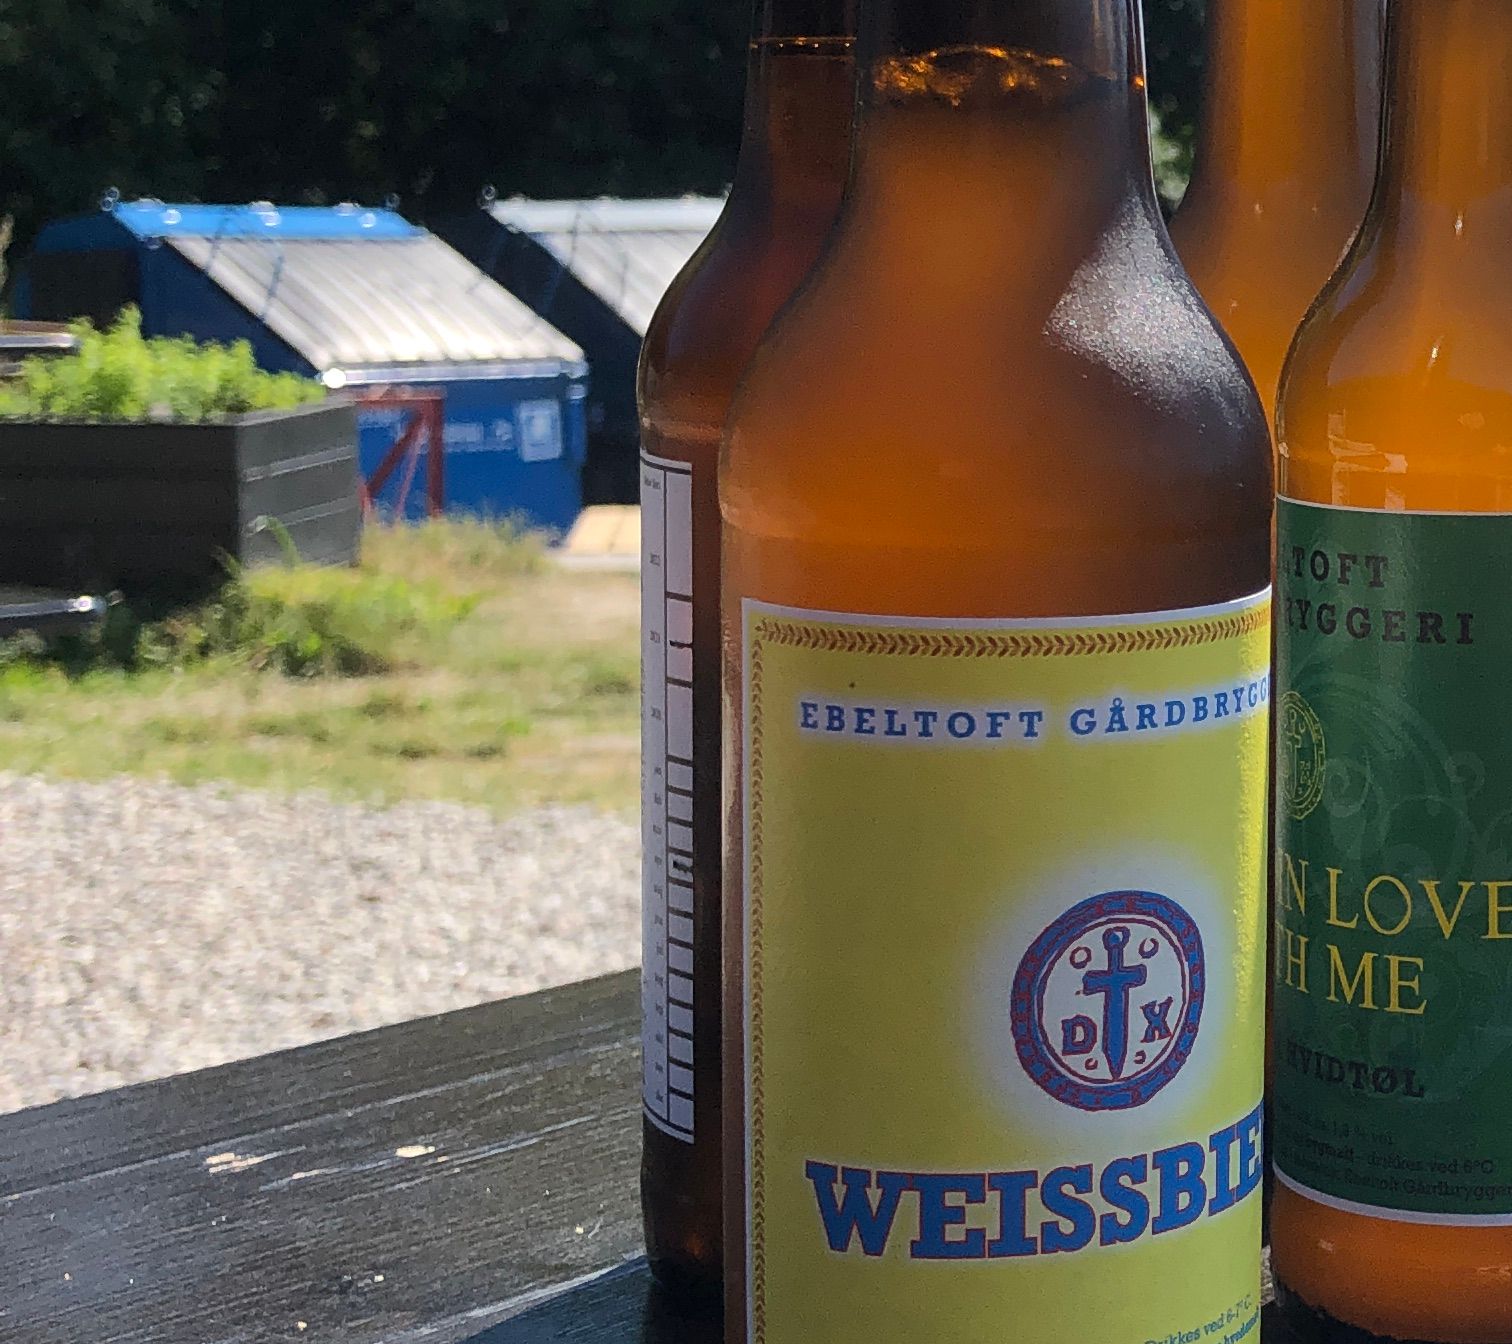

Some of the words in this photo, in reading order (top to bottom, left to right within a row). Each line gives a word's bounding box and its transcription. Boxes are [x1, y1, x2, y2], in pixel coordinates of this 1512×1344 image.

[1284, 544, 1389, 588] TOFT
[800, 701, 1045, 739] EBELTOFT
[1069, 674, 1270, 736] GÅRDBRYGG
[1325, 944, 1428, 1015] ME
[805, 1100, 1264, 1261] WEISSBIE
[1204, 1312, 1225, 1337] ved
